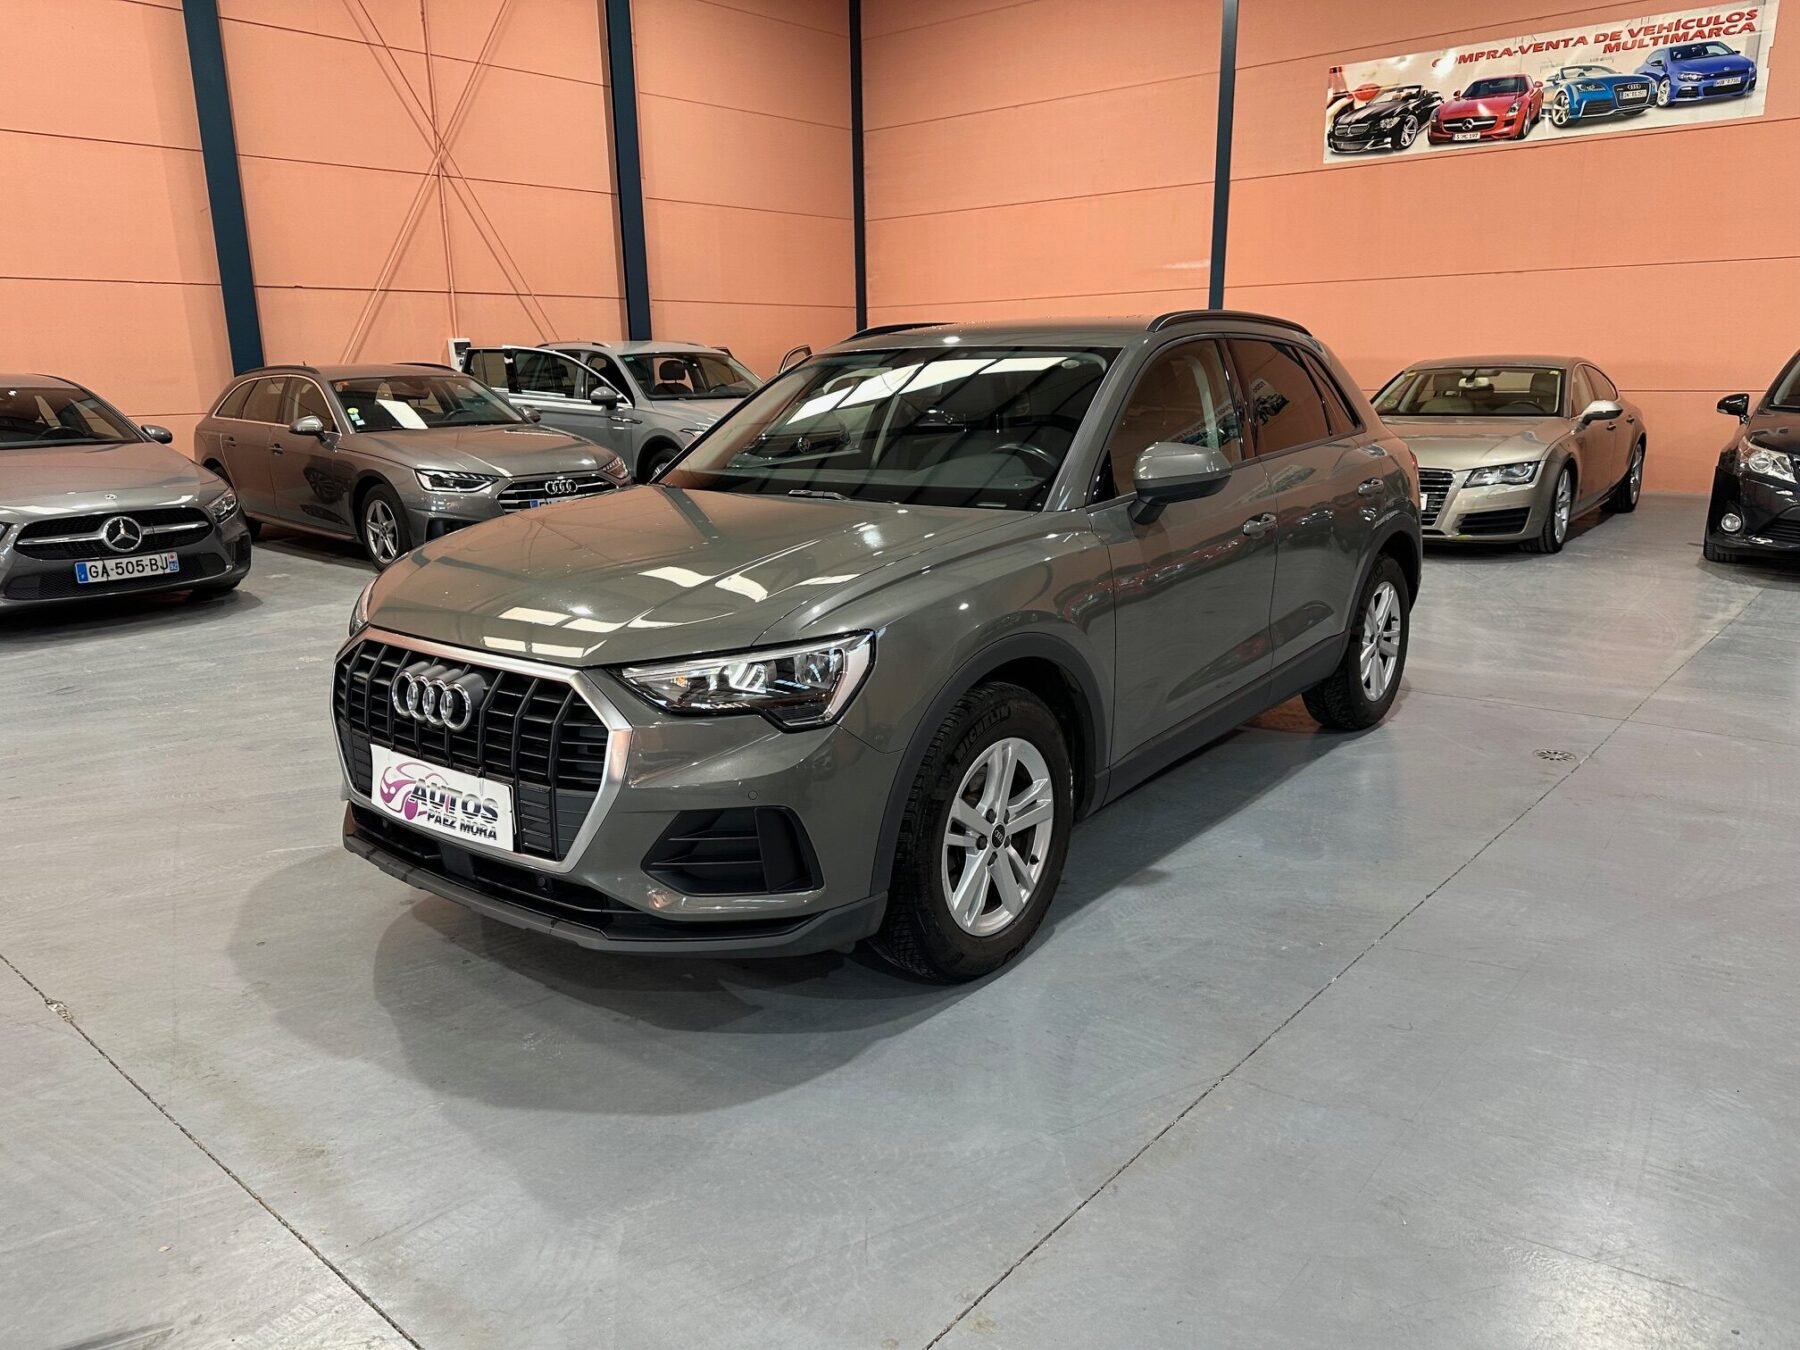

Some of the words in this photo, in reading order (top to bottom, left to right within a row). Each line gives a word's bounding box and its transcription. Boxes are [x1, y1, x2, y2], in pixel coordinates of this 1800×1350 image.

[1431, 35, 1588, 69] CMPRA-VENTA
[1594, 30, 1623, 45] DE
[1627, 9, 1758, 38] VEHÍCULOS
[1602, 22, 1756, 54] MULTIMARCA
[88, 556, 169, 578] GA-505-BJ
[408, 778, 499, 824] AUTOS
[460, 818, 498, 841] MORA
